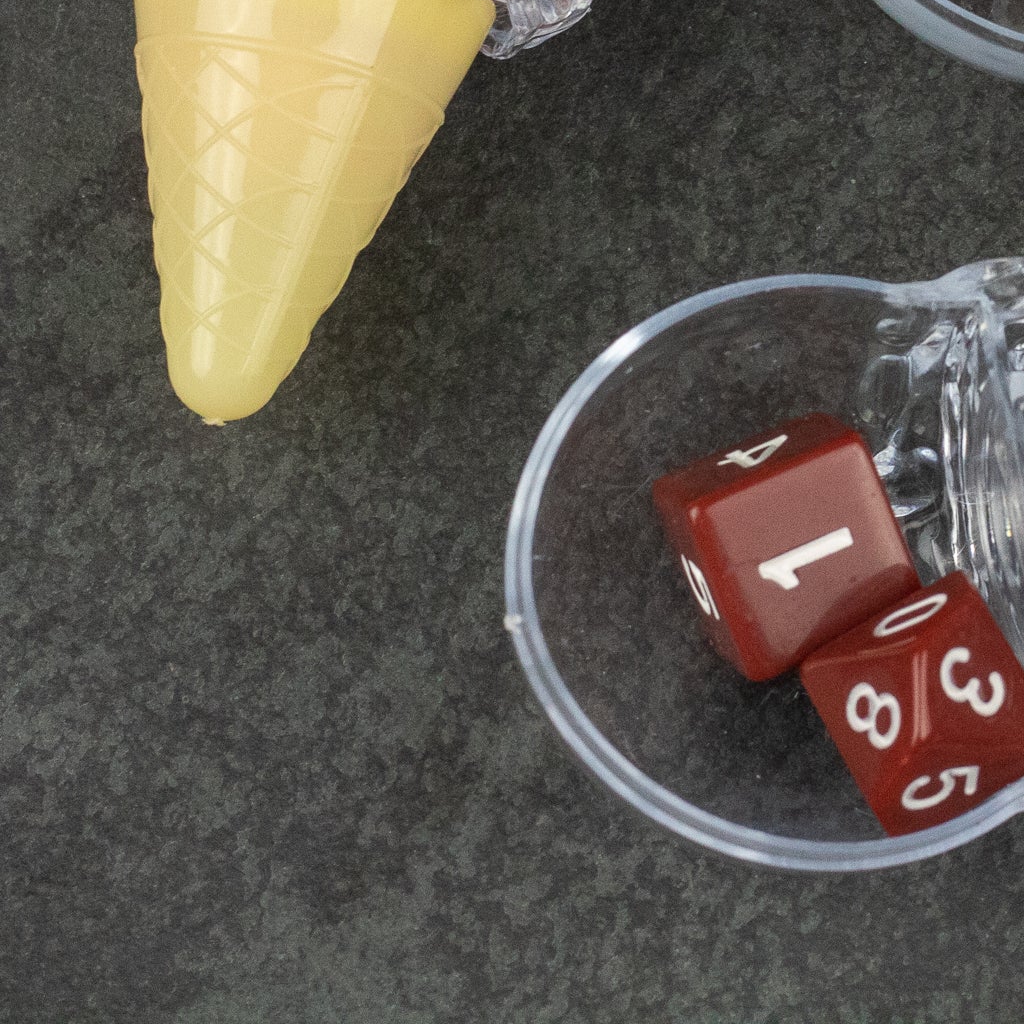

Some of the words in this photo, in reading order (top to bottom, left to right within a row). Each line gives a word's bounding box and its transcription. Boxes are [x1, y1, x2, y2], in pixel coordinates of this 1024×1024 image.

[758, 526, 854, 590] 1
[940, 647, 1006, 717] 3
[845, 681, 901, 750] 8
[902, 765, 980, 811] 5
